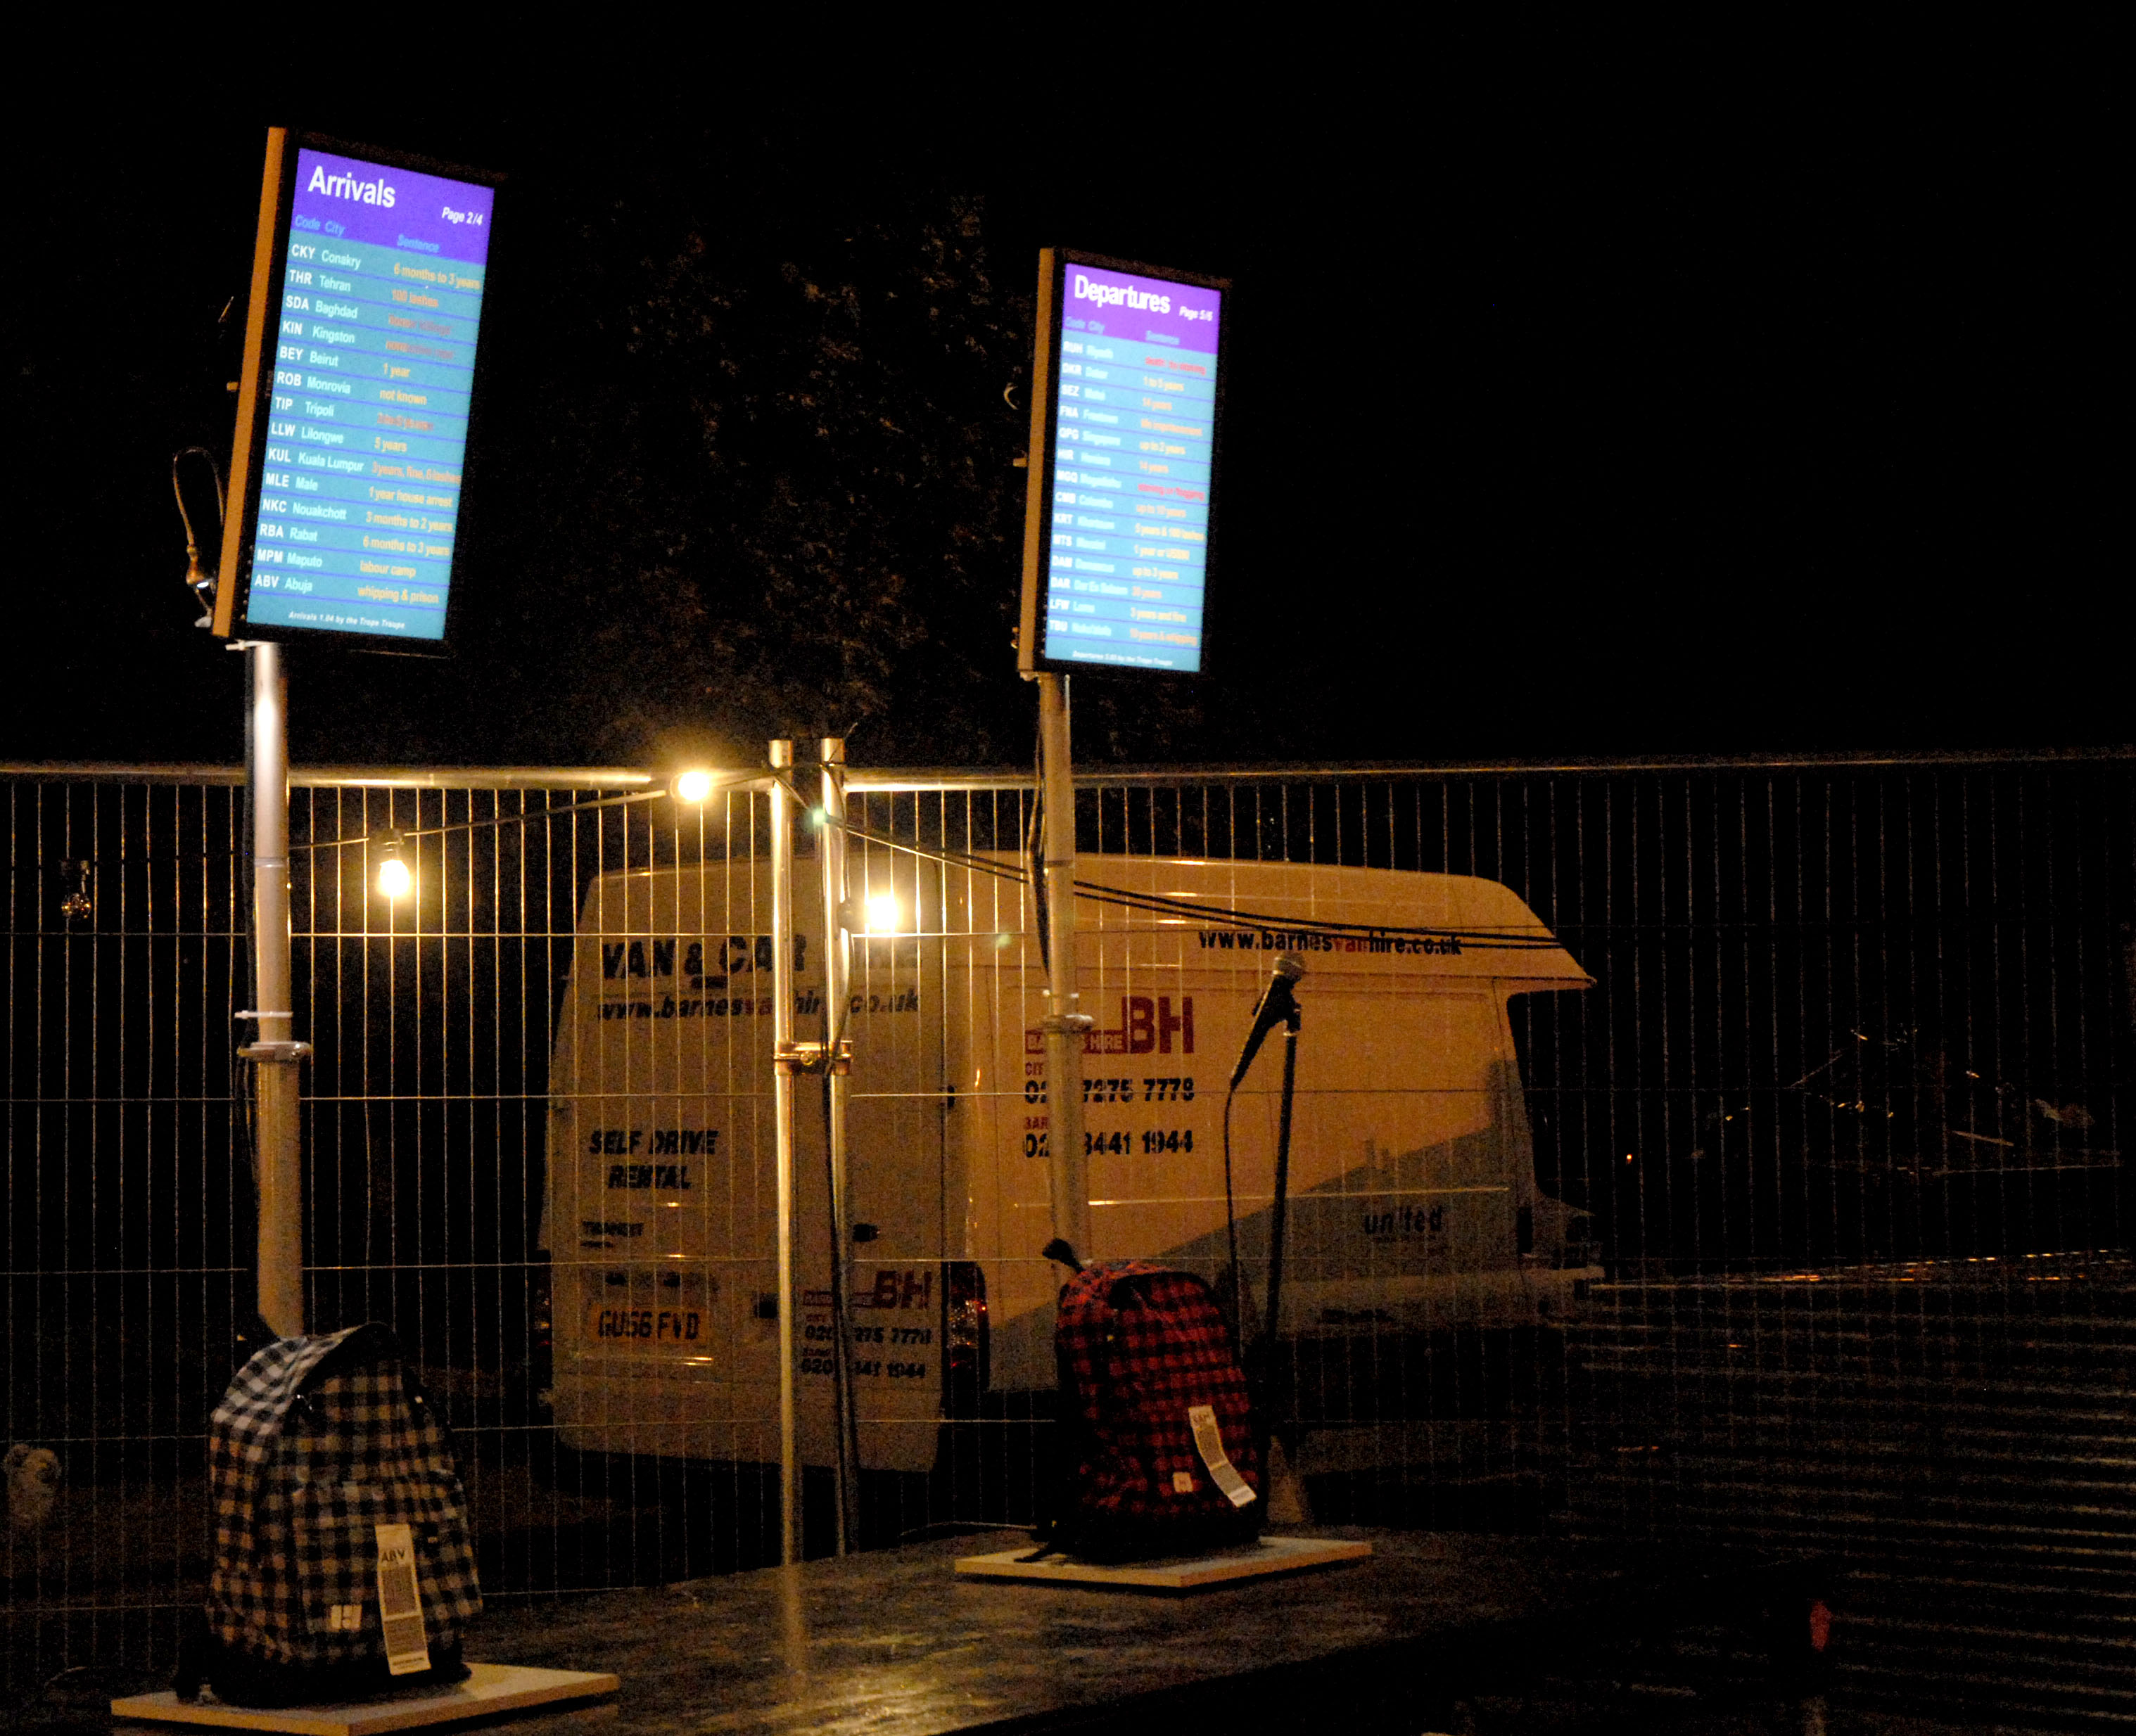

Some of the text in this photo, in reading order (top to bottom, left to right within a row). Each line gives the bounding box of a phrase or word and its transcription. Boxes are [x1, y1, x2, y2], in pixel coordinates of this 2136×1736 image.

[307, 165, 396, 208] Arrivals
[295, 215, 320, 231] Code
[325, 221, 345, 237] City
[442, 207, 483, 226] Page 2/4
[291, 244, 315, 260] CKY
[322, 250, 361, 270] Conakry
[289, 269, 312, 285] THR
[319, 275, 351, 292] Tehran
[1074, 274, 1171, 314] Departures
[286, 295, 358, 319] SDA Baghdad
[282, 321, 355, 343] KIN Kingston
[279, 345, 303, 360] BEY
[310, 351, 338, 366] Beirut
[276, 371, 302, 386] ROB
[307, 376, 351, 395] Monrovia
[275, 397, 335, 418] TIP Tripoli
[271, 422, 295, 437] LLW
[301, 427, 344, 445] Lilongwe
[268, 447, 291, 462] KUL
[298, 452, 326, 468] Kuala
[327, 454, 364, 473] Lumpur
[265, 473, 289, 487] MLE
[295, 477, 318, 491] Male
[262, 499, 287, 513] NKC
[260, 524, 284, 538] RBA
[290, 527, 318, 542] Rabat
[257, 549, 284, 563] MPM
[287, 553, 323, 568] Maputo
[254, 574, 279, 588] ABV
[284, 577, 312, 594] Abuja
[602, 938, 676, 980] VAN
[684, 942, 704, 976] &
[1121, 996, 1195, 1054] BH
[589, 1129, 719, 1155] SELF DRIVE
[608, 1165, 692, 1190] RENTAL
[874, 1270, 932, 1309] BH
[598, 1310, 652, 1338] GU56
